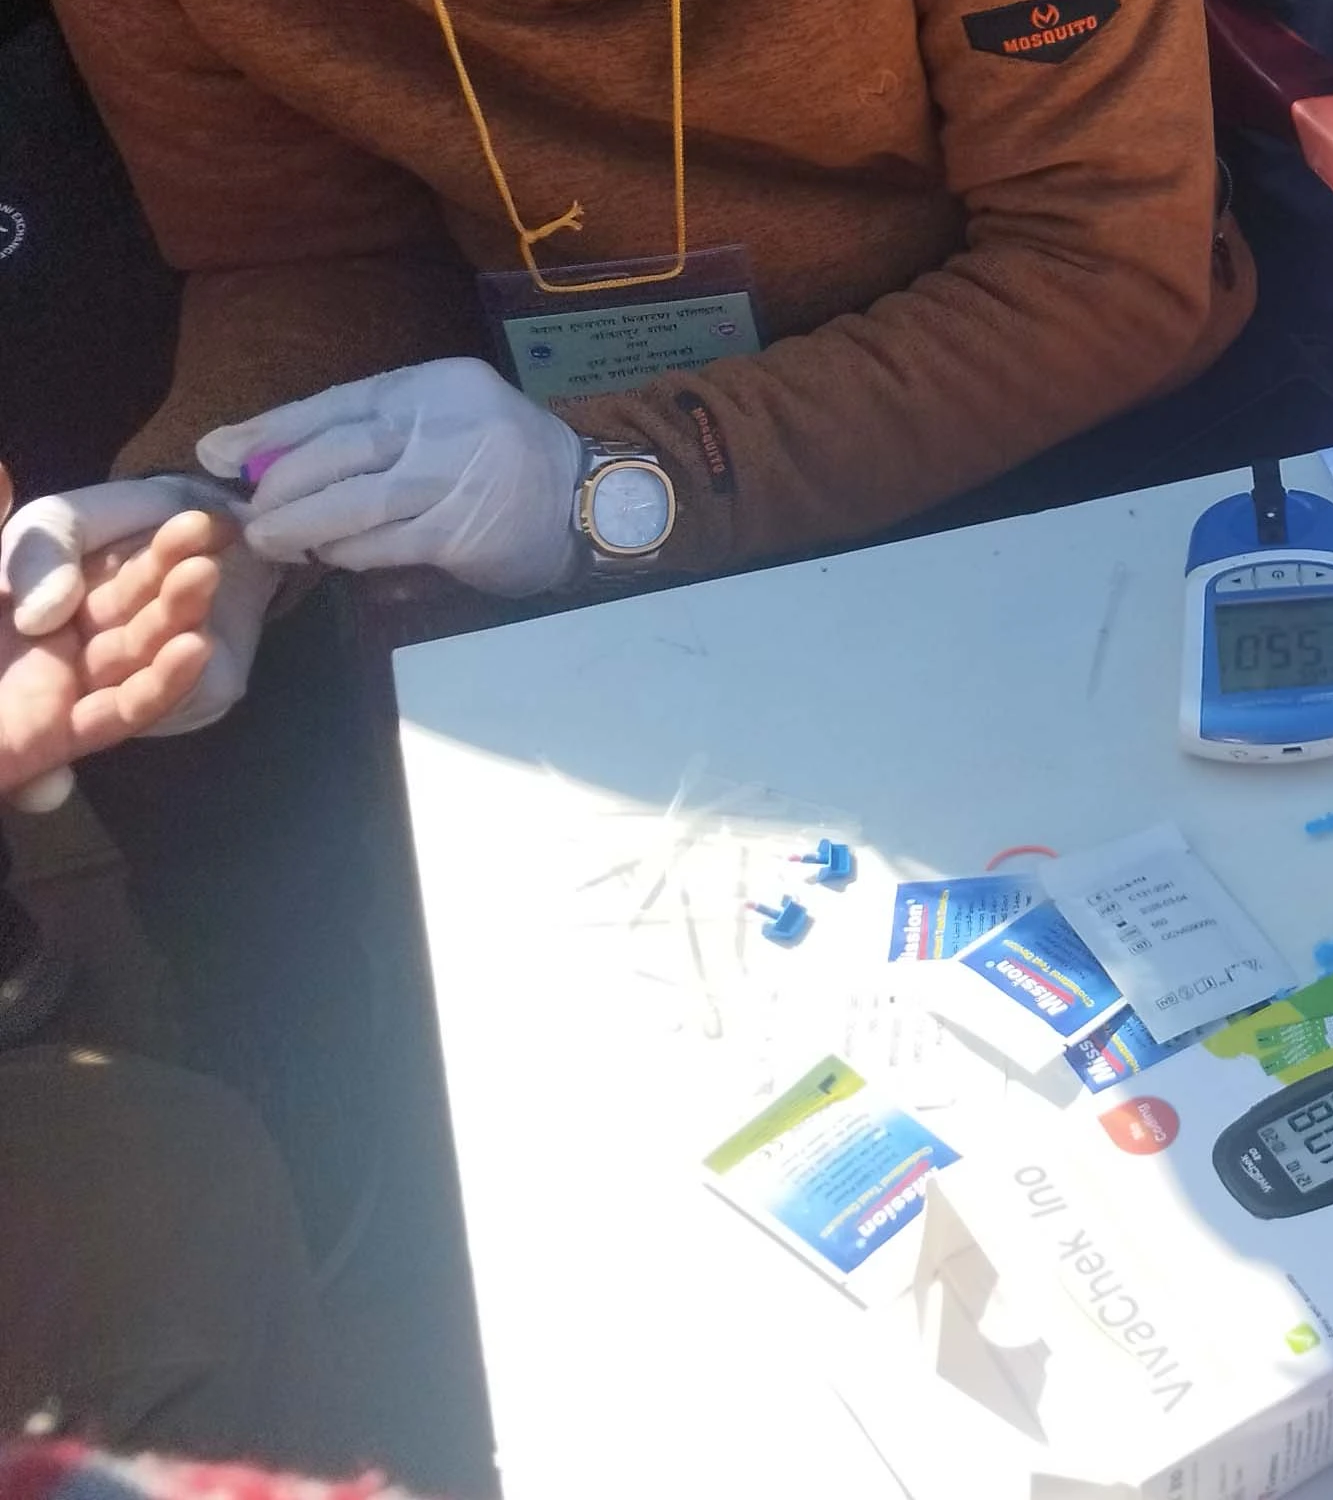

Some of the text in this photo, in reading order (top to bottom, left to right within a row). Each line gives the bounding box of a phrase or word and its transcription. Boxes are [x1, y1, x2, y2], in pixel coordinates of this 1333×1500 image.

[1002, 15, 1098, 52] MOSQUITO
[996, 959, 1068, 1017] Mission
[1138, 1102, 1167, 1142] Coding
[1013, 1165, 1194, 1413] VivaChek Ino
